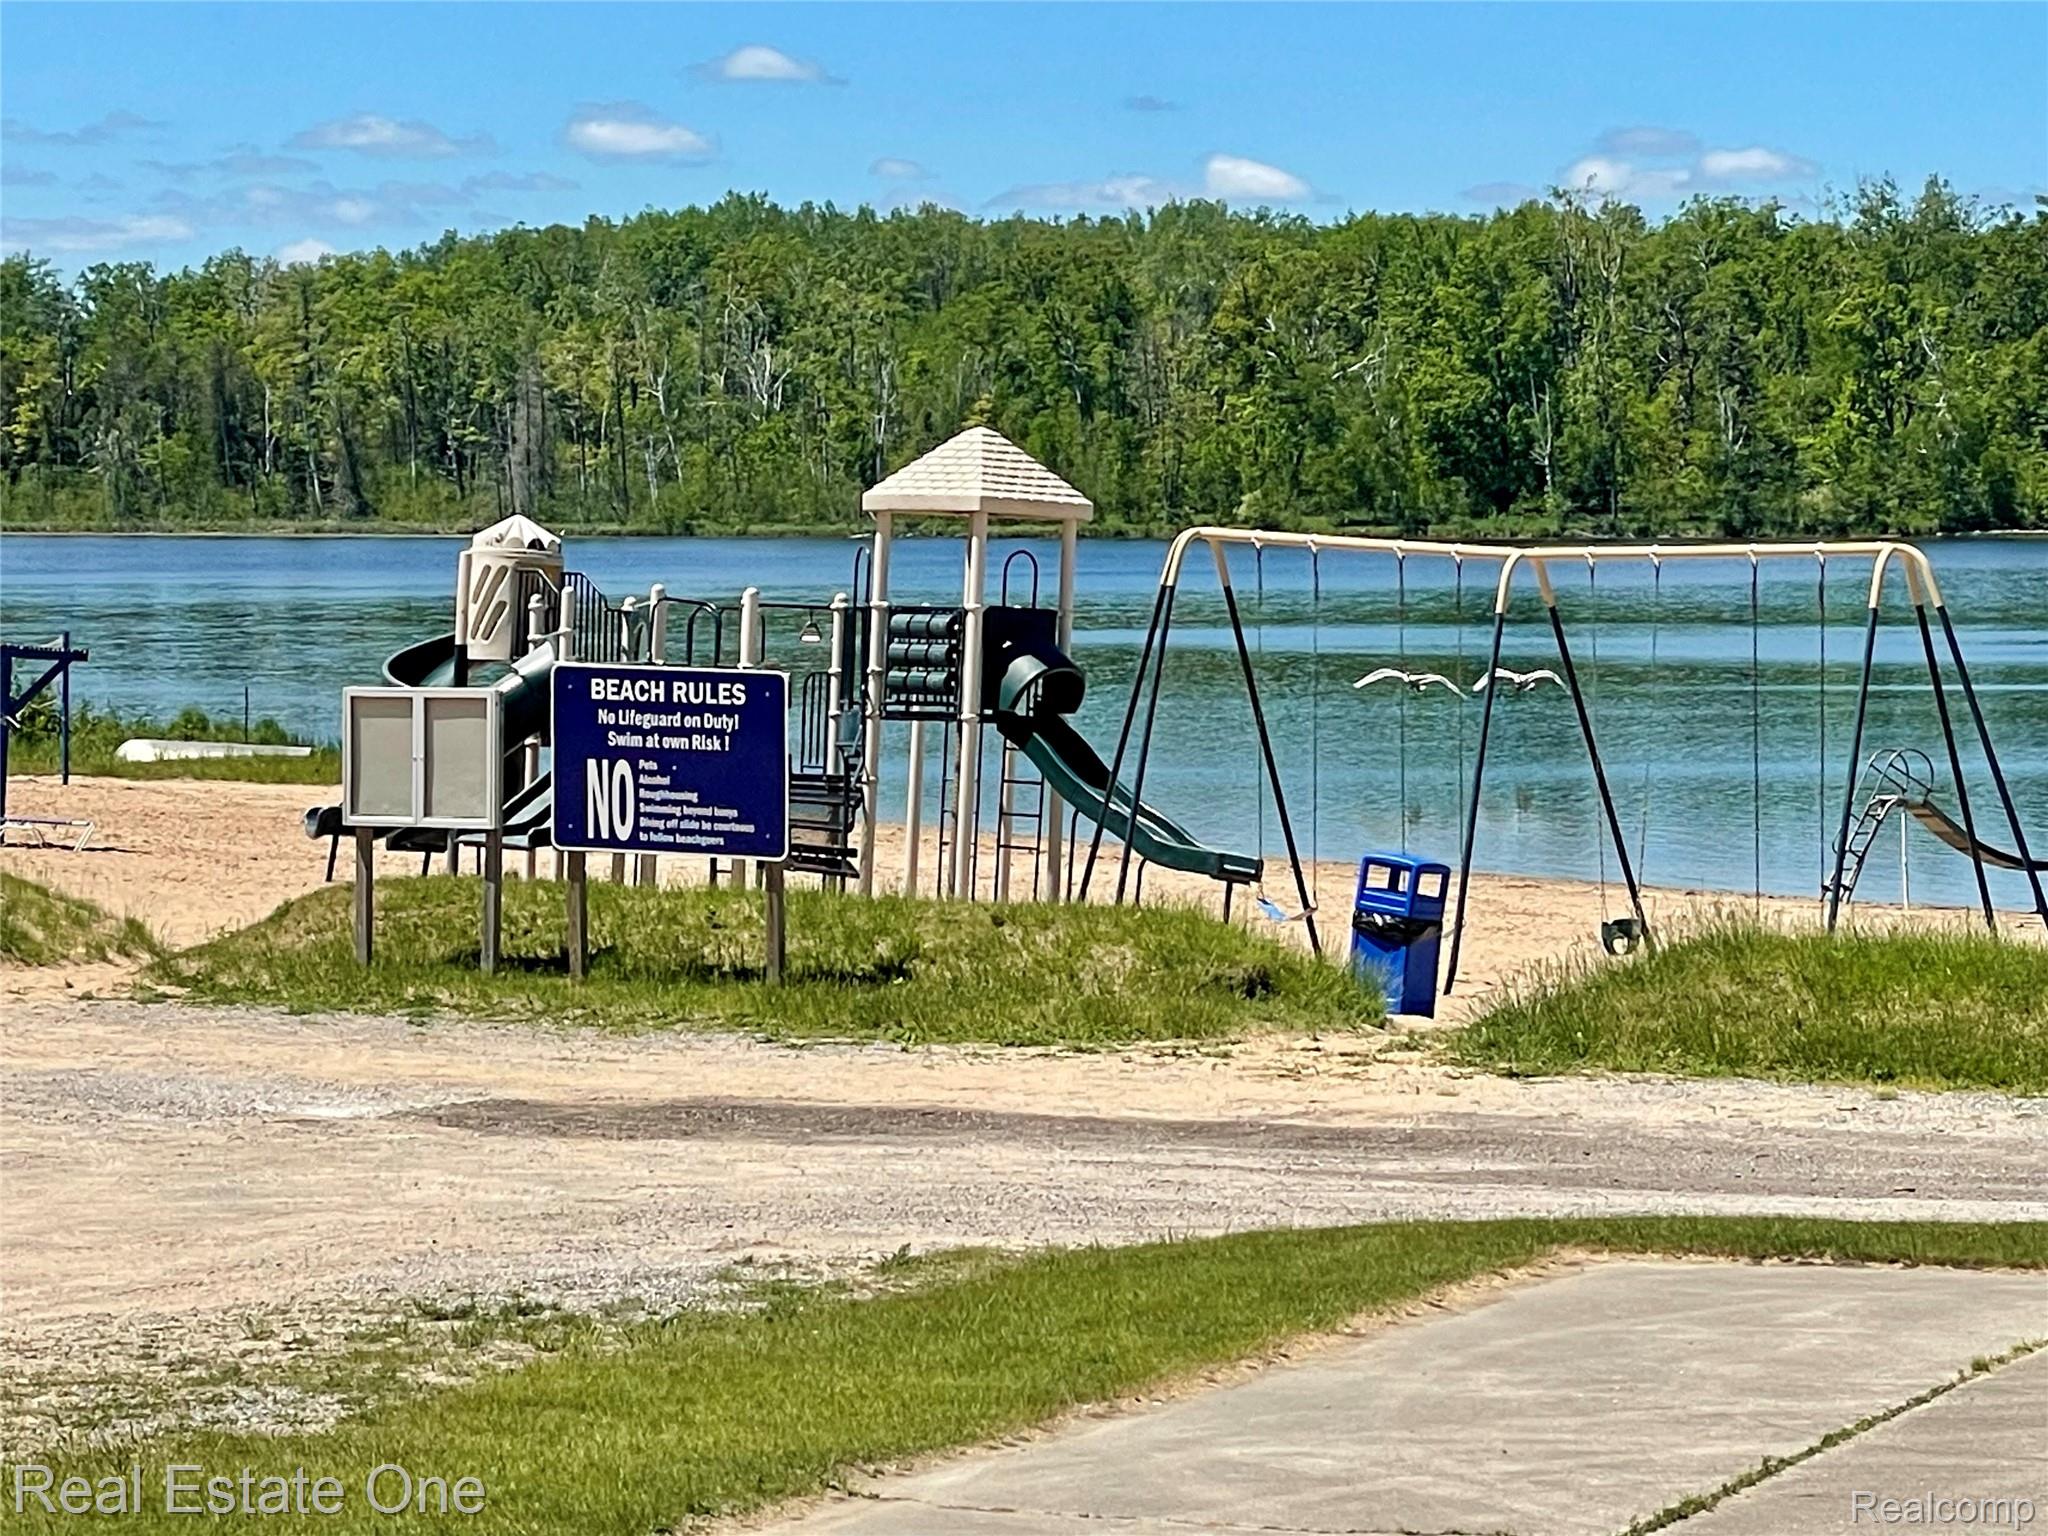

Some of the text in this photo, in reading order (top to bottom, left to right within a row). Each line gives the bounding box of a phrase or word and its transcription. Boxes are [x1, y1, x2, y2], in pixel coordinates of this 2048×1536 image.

[590, 678, 747, 706] BEACH RULES
[598, 709, 739, 733] No Lifeguard on Duty!
[607, 731, 643, 748] Swim
[646, 734, 660, 749] at
[662, 737, 689, 750] own
[692, 734, 721, 751] Risk
[638, 759, 658, 770] Pets
[638, 774, 671, 785] Alcohol
[586, 758, 635, 842] NO
[638, 788, 699, 803] Roughhousing
[639, 802, 682, 817] Swimming
[683, 805, 713, 818] beyond
[639, 817, 665, 830] Diving
[666, 819, 678, 829] off
[680, 819, 700, 830] slide
[701, 820, 712, 830] be
[639, 831, 725, 846] to fellow beachgoers
